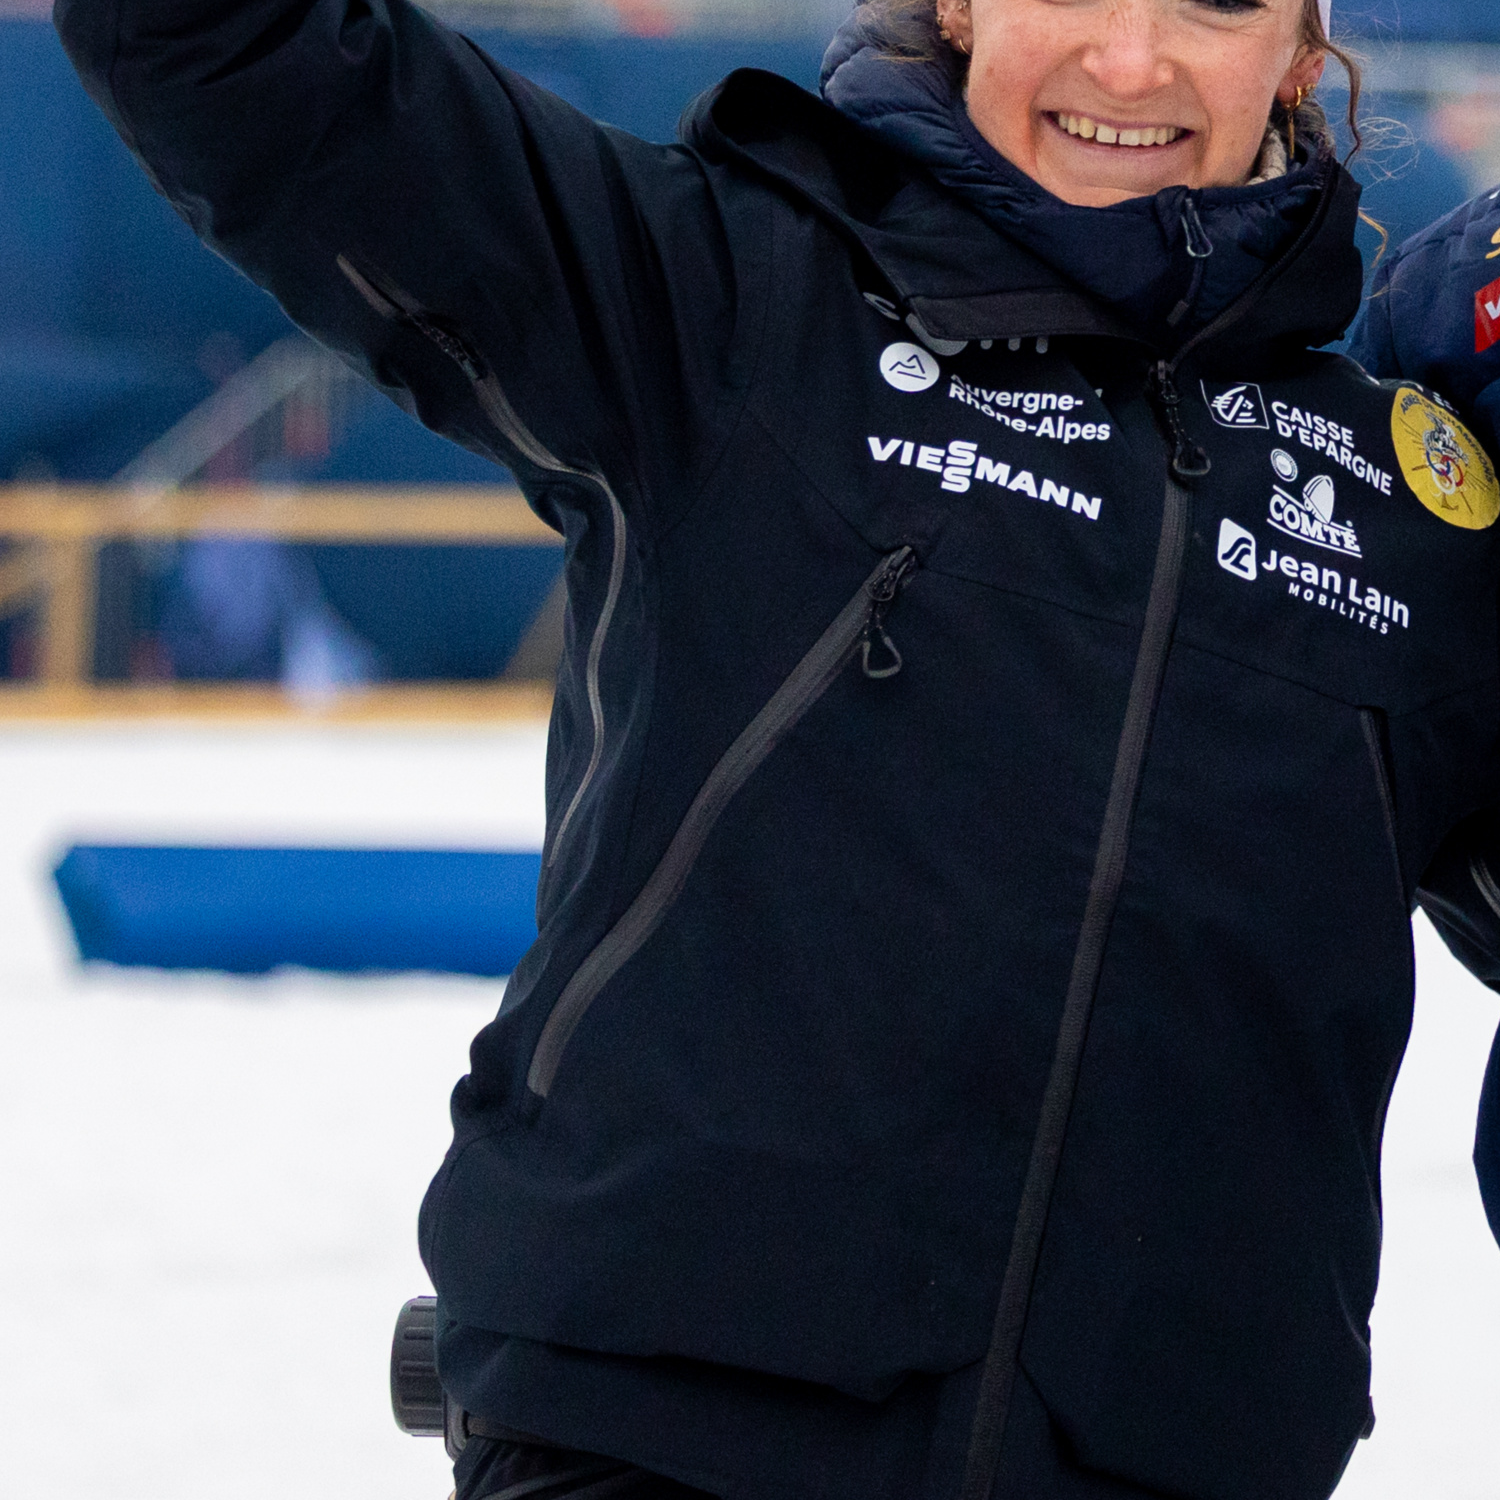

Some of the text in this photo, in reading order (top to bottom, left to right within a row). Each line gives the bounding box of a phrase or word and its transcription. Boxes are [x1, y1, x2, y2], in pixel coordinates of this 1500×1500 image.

[949, 382, 1111, 444] Rhône-Alpes
[950, 374, 1084, 414] Auvergne-
[1271, 401, 1355, 449] CAISSE
[867, 436, 1102, 521] VIESSMANN
[1276, 418, 1393, 496] D'EPARGNE
[1261, 549, 1410, 628] Jean Lain
[1289, 582, 1389, 635] MOBILITÉS
